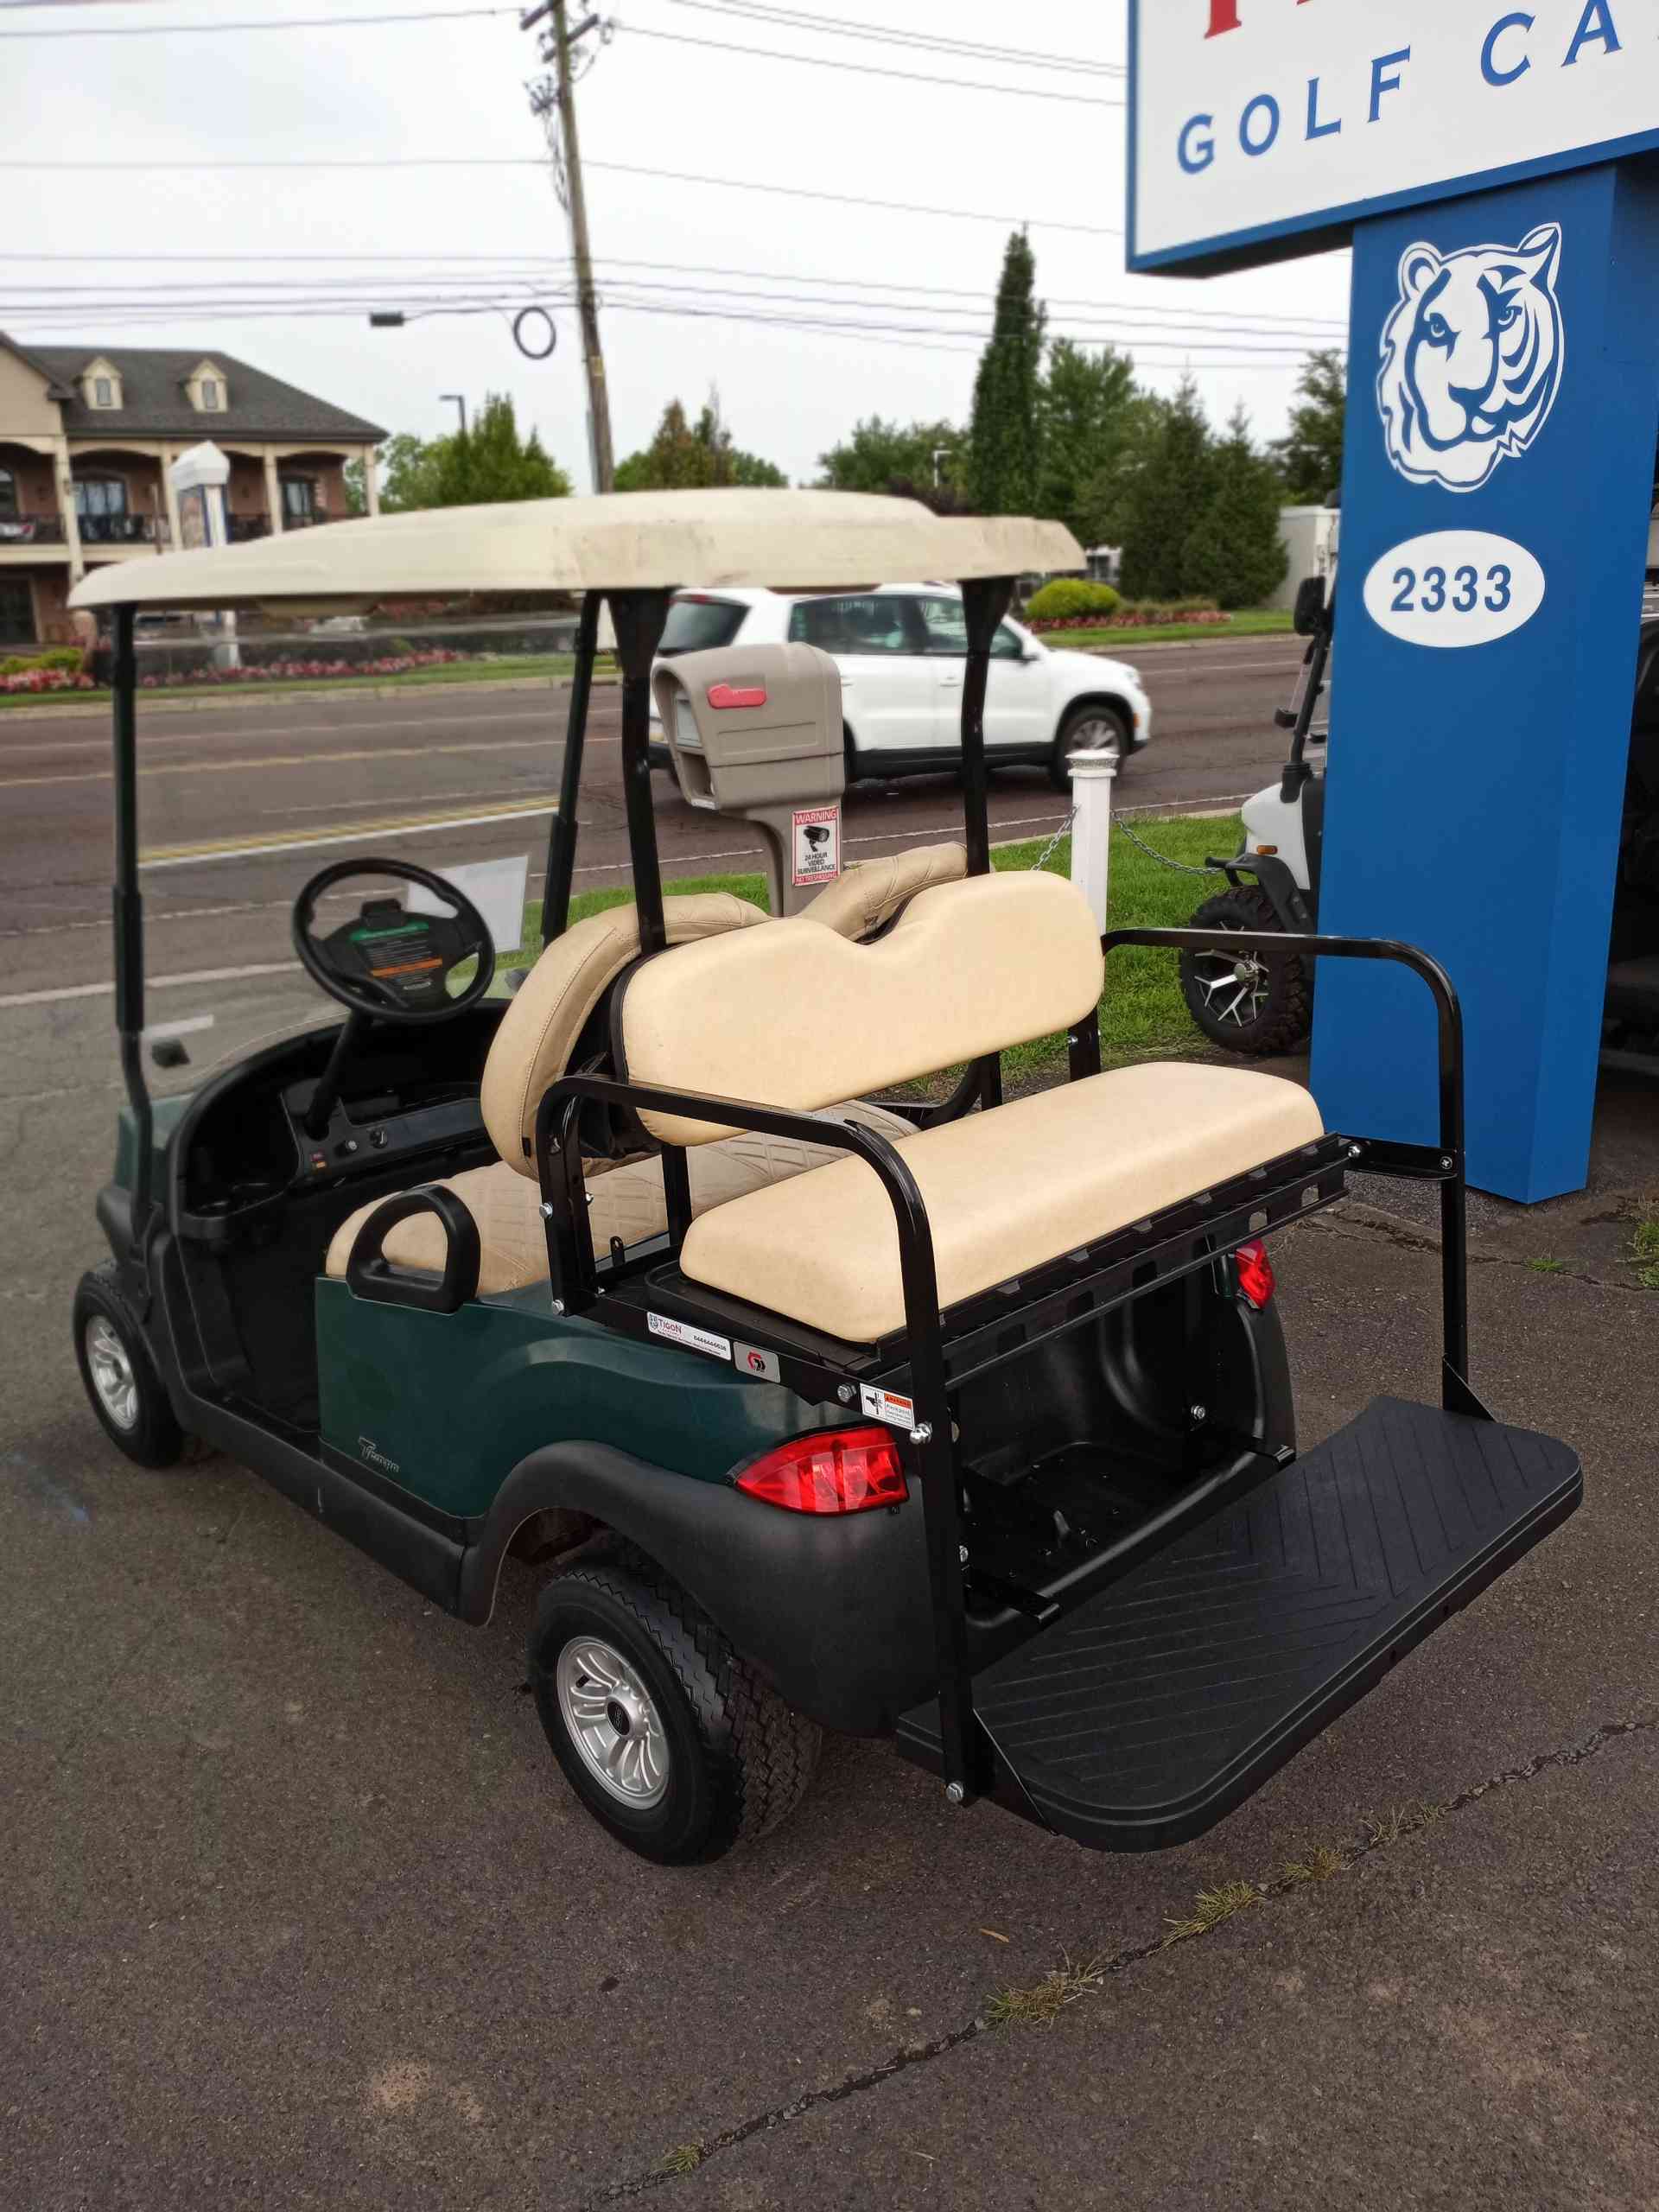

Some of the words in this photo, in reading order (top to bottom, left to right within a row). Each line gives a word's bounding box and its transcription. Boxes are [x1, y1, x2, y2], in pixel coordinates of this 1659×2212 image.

[1178, 45, 1411, 175] GOLF
[1480, 0, 1659, 87] CA
[1389, 564, 1511, 613] 2333
[796, 809, 836, 823] WARNING
[658, 1318, 683, 1335] TIGON
